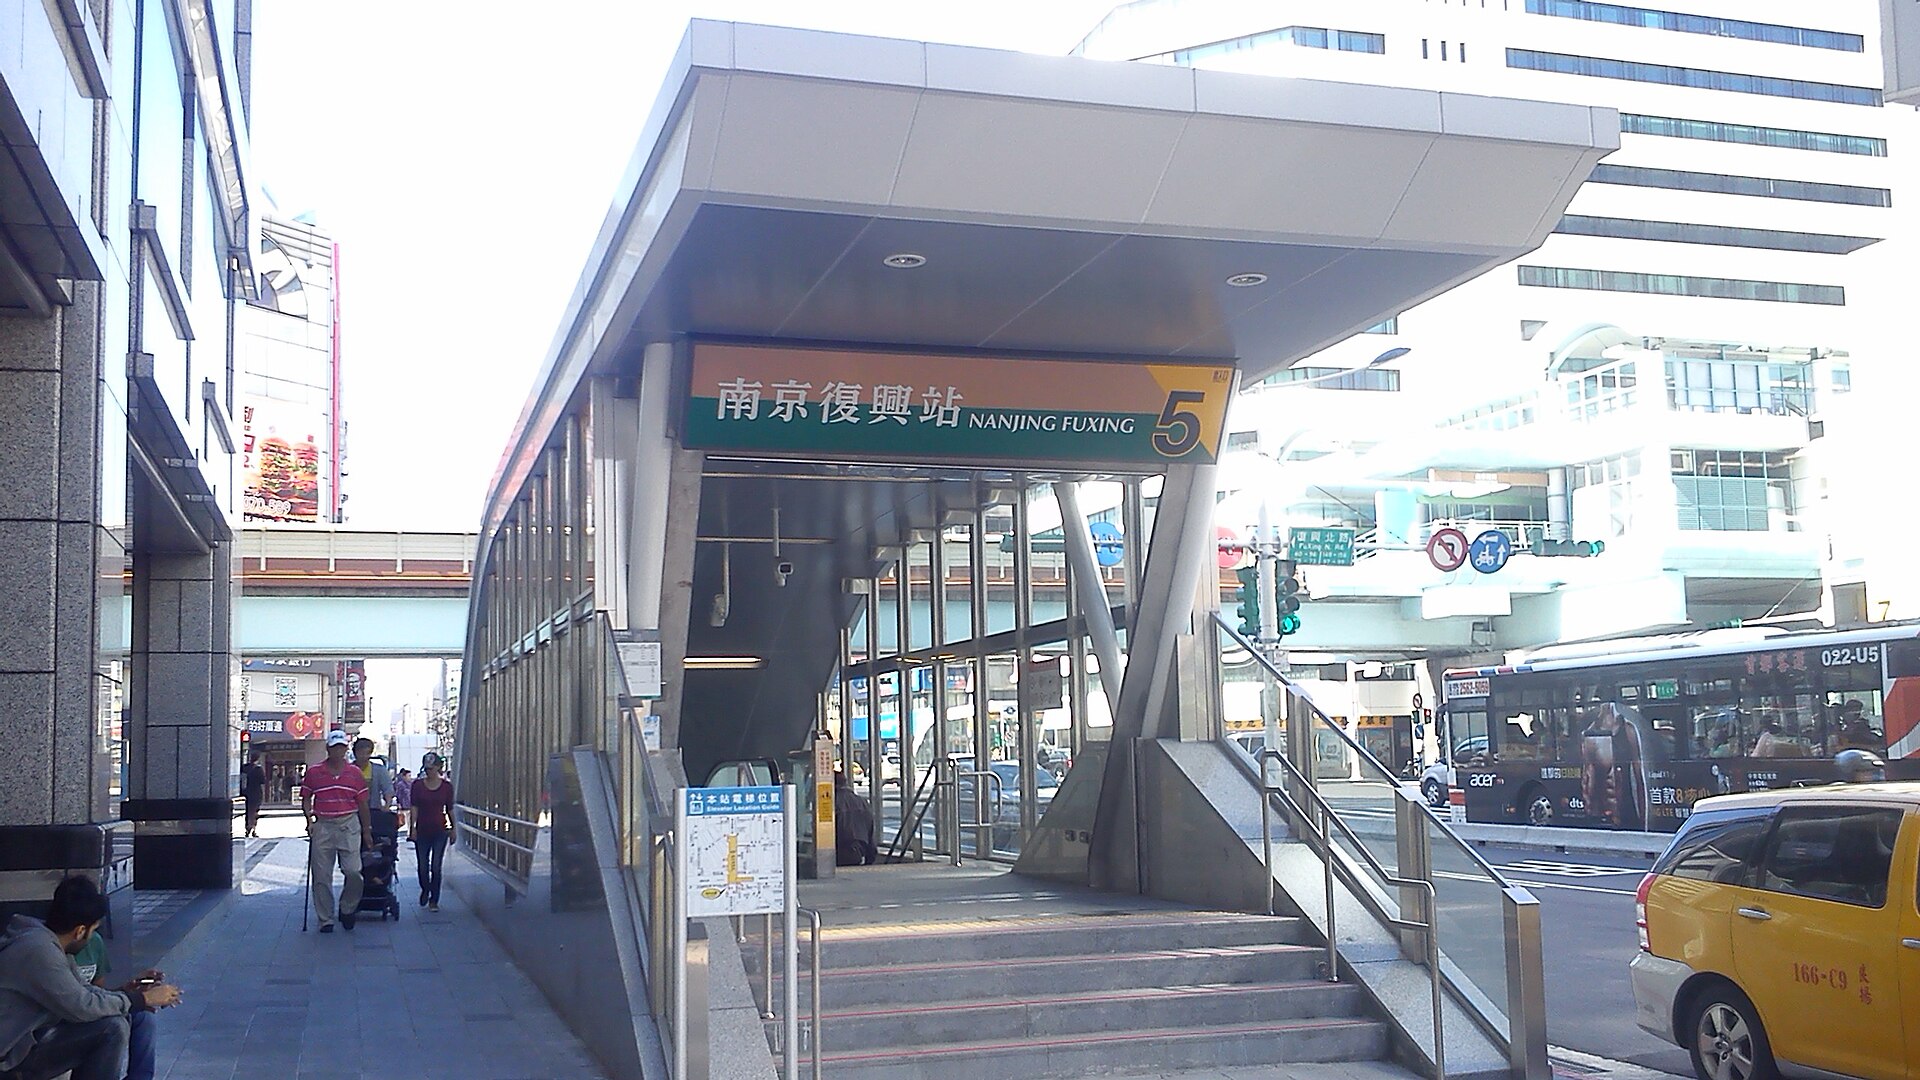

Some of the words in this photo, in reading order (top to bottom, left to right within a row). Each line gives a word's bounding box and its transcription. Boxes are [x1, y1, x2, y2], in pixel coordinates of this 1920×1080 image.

[717, 377, 963, 427] 南京復興站
[968, 412, 1057, 433] NANJING
[1061, 416, 1135, 434] FUXING
[1151, 390, 1205, 457] 5
[1821, 646, 1879, 667] 022-U5
[1469, 773, 1497, 787] acer
[706, 792, 780, 805] 本站電梯位置
[706, 804, 733, 812] Elevator
[733, 804, 761, 812] Location
[1569, 797, 1584, 809] dts
[1792, 962, 1848, 991] 166-C9
